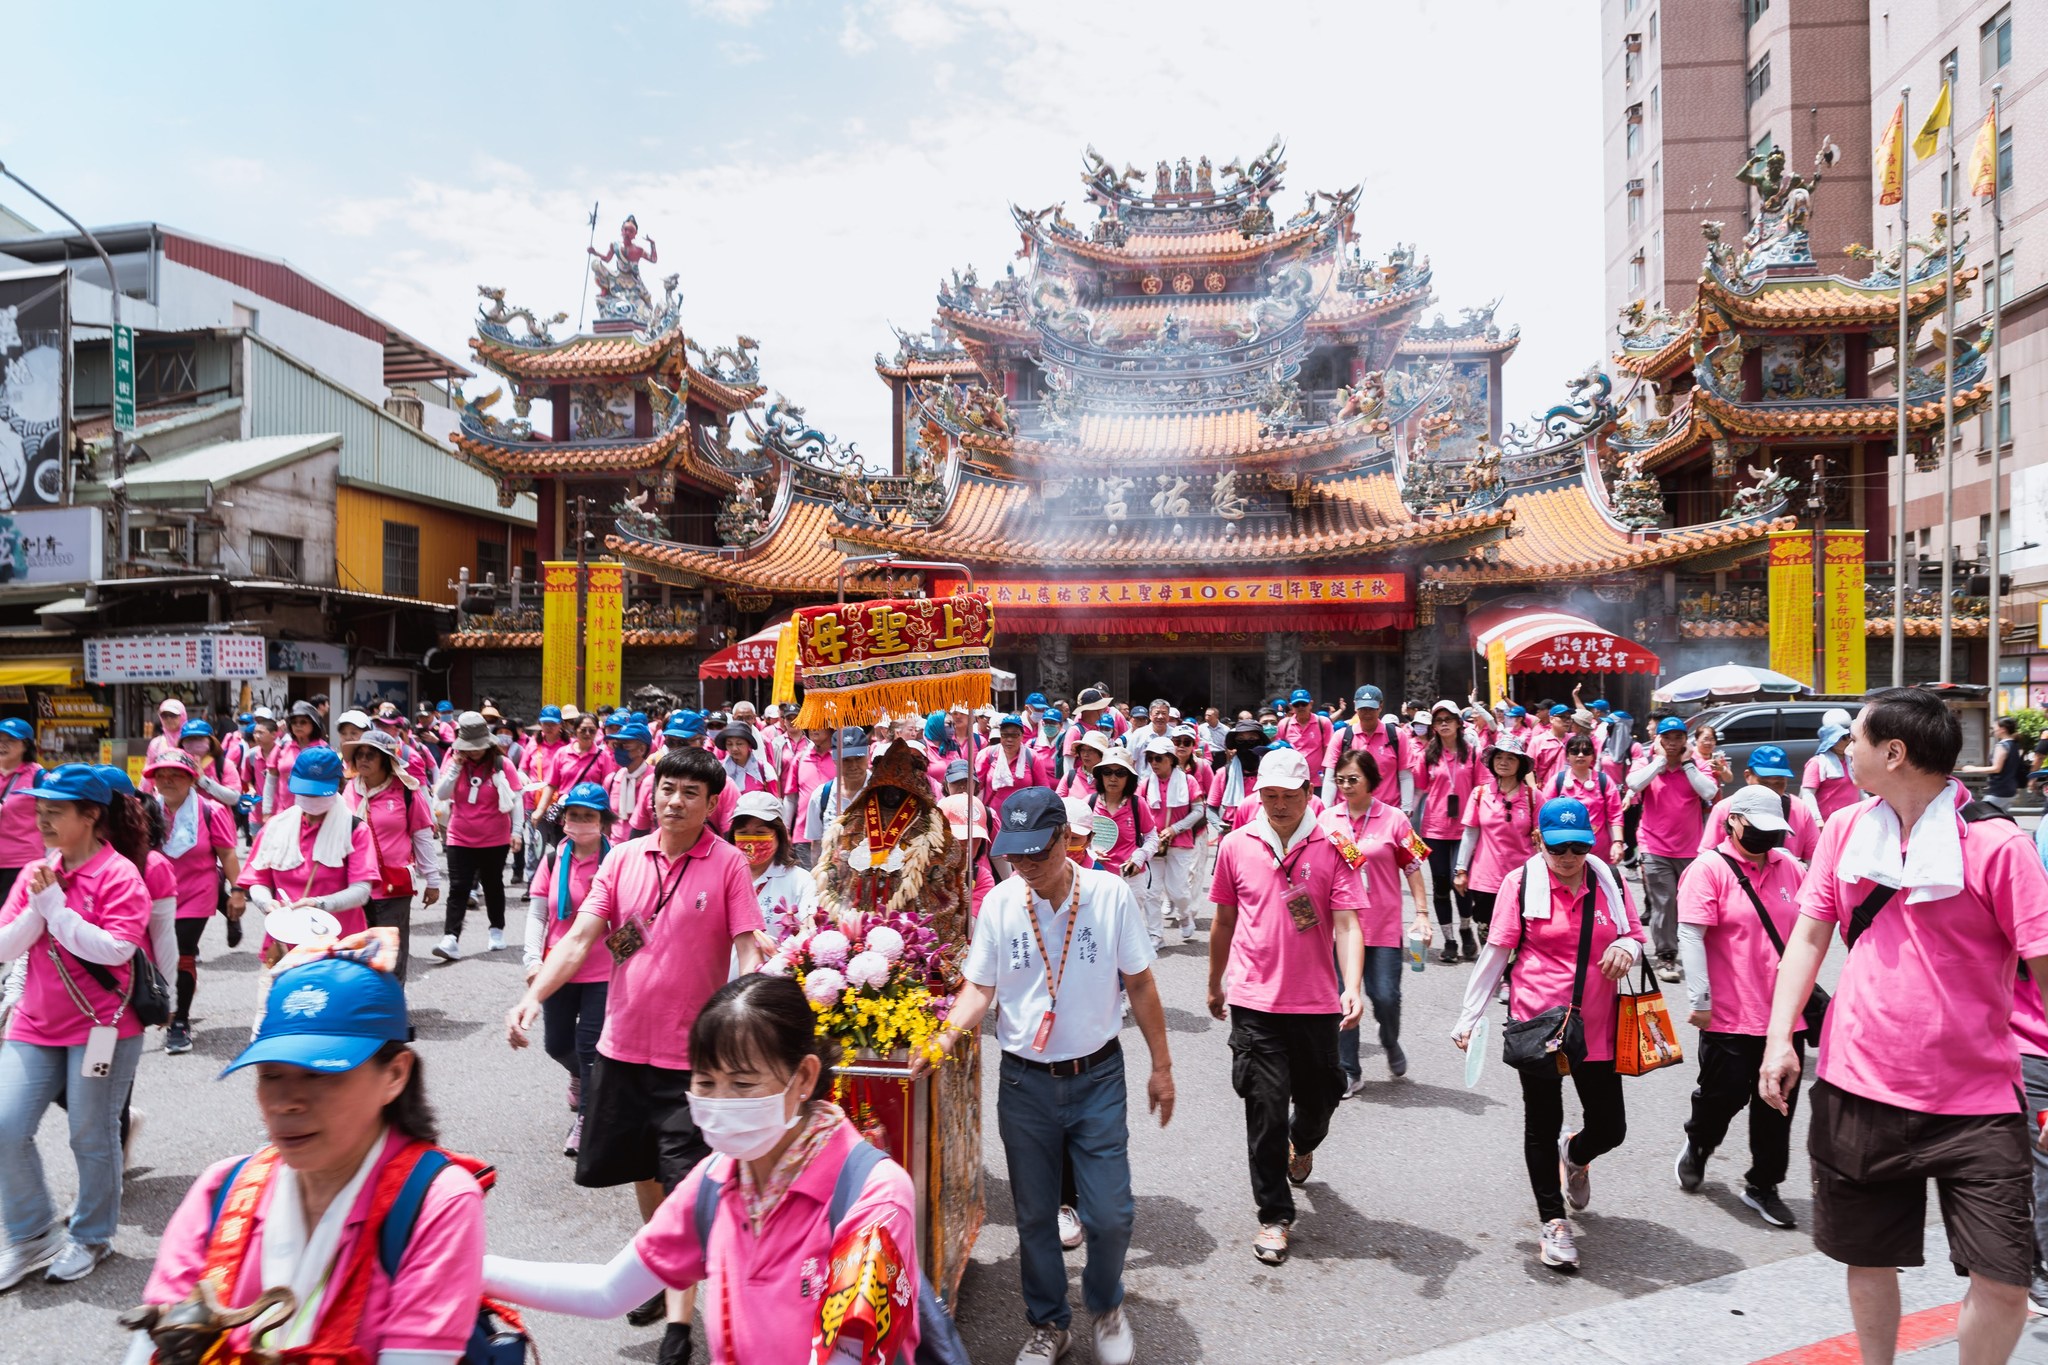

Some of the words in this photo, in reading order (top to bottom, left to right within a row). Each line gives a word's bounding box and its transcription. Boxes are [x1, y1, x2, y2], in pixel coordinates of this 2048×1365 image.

[1144, 271, 1223, 294] 慈祐宮
[117, 336, 130, 395] 饒河街
[1097, 470, 1249, 521] 慈祐宮
[1570, 637, 1615, 652] 台北市
[726, 658, 776, 673] 松山慈
[1541, 651, 1629, 668] 松山慈祐宮
